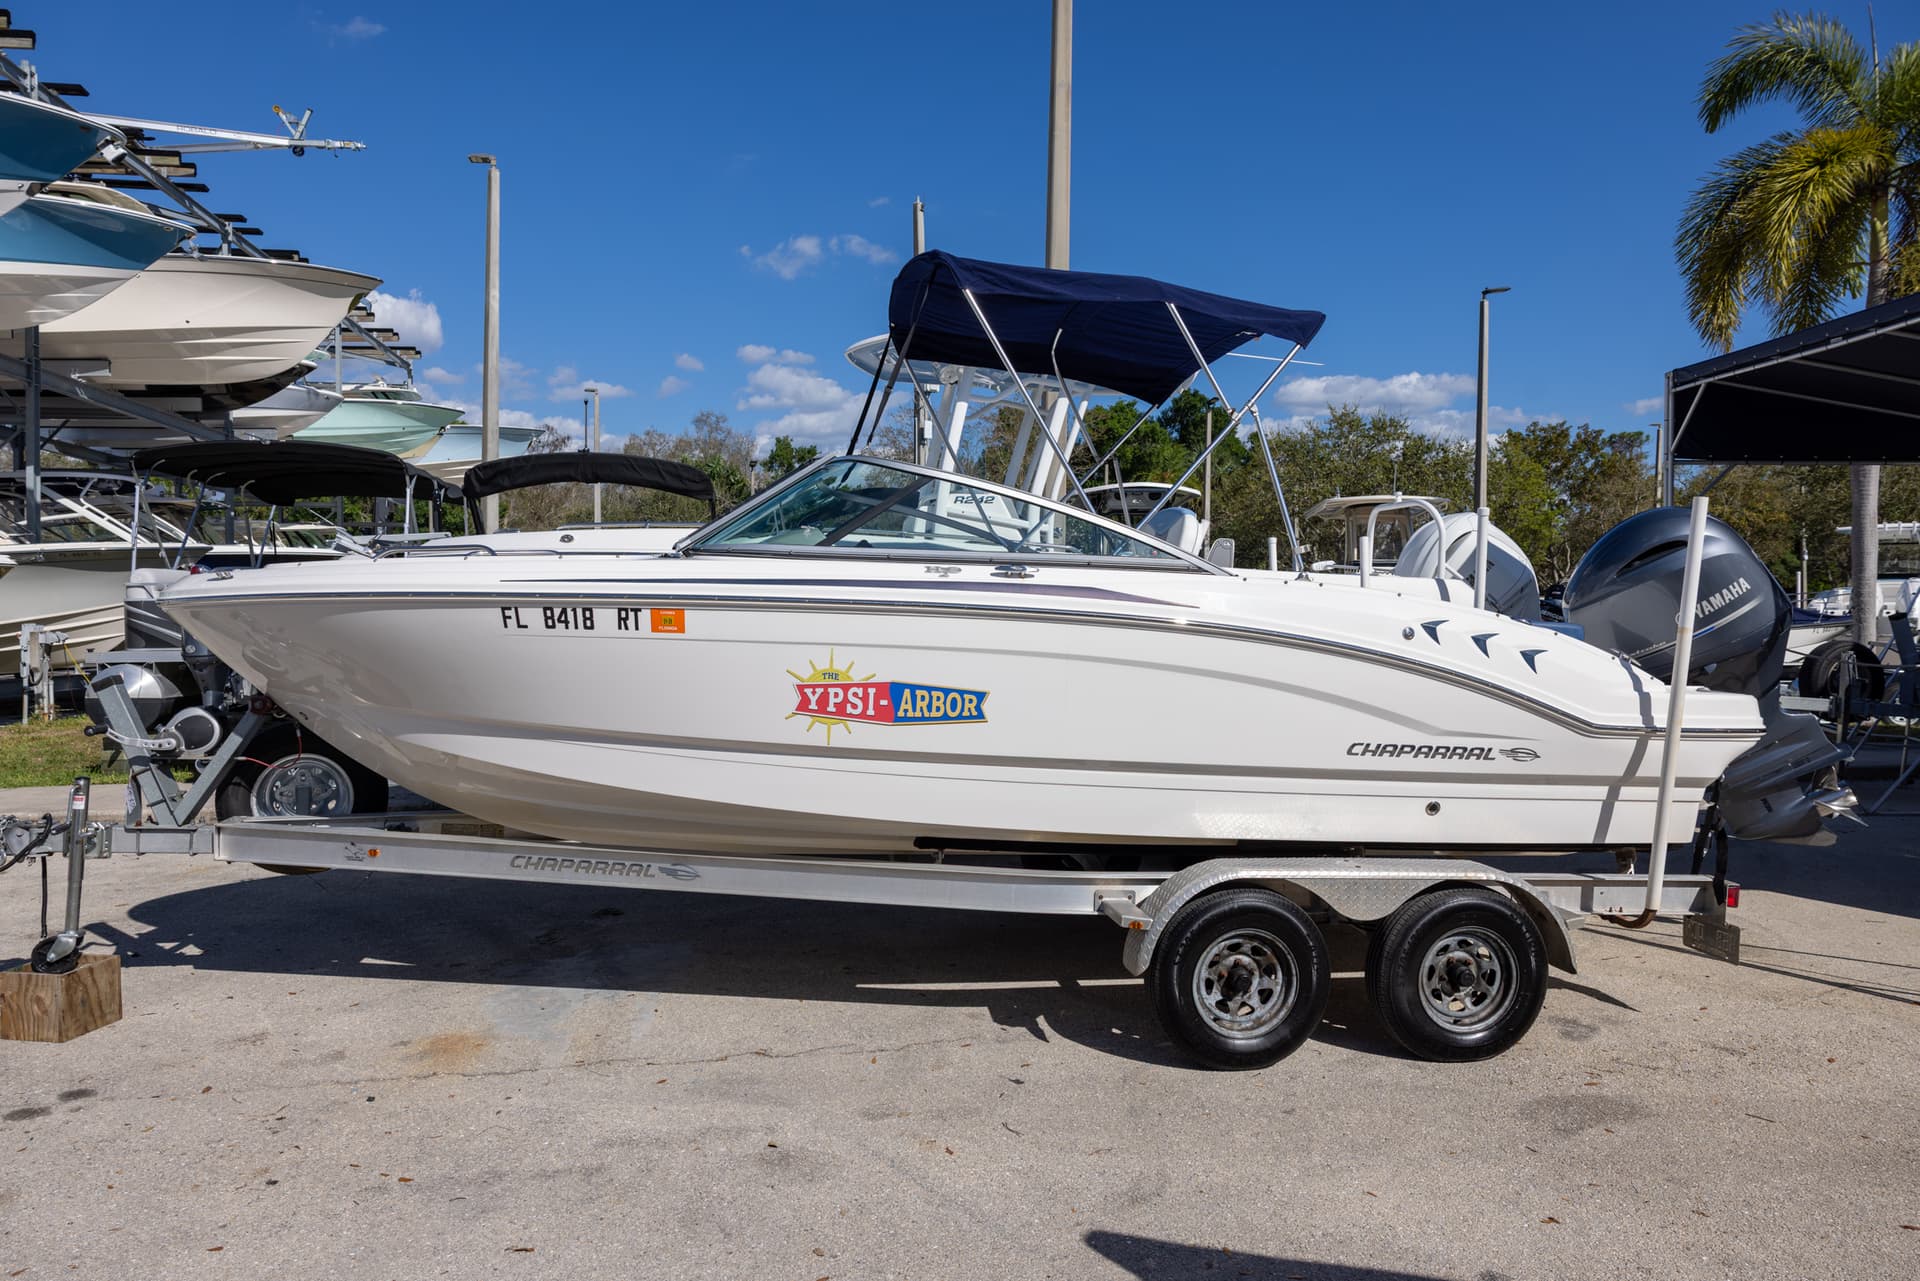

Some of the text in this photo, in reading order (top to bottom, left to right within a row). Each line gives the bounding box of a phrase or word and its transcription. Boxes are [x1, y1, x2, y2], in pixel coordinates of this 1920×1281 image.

[1694, 576, 1751, 619] YAMAHA
[500, 606, 642, 632] FL 8418 RT
[822, 671, 840, 681] THE
[804, 686, 979, 719] YPSI- ARBOR
[1346, 743, 1496, 760] CHAPARRAL
[509, 855, 655, 879] CHAPARRAL
